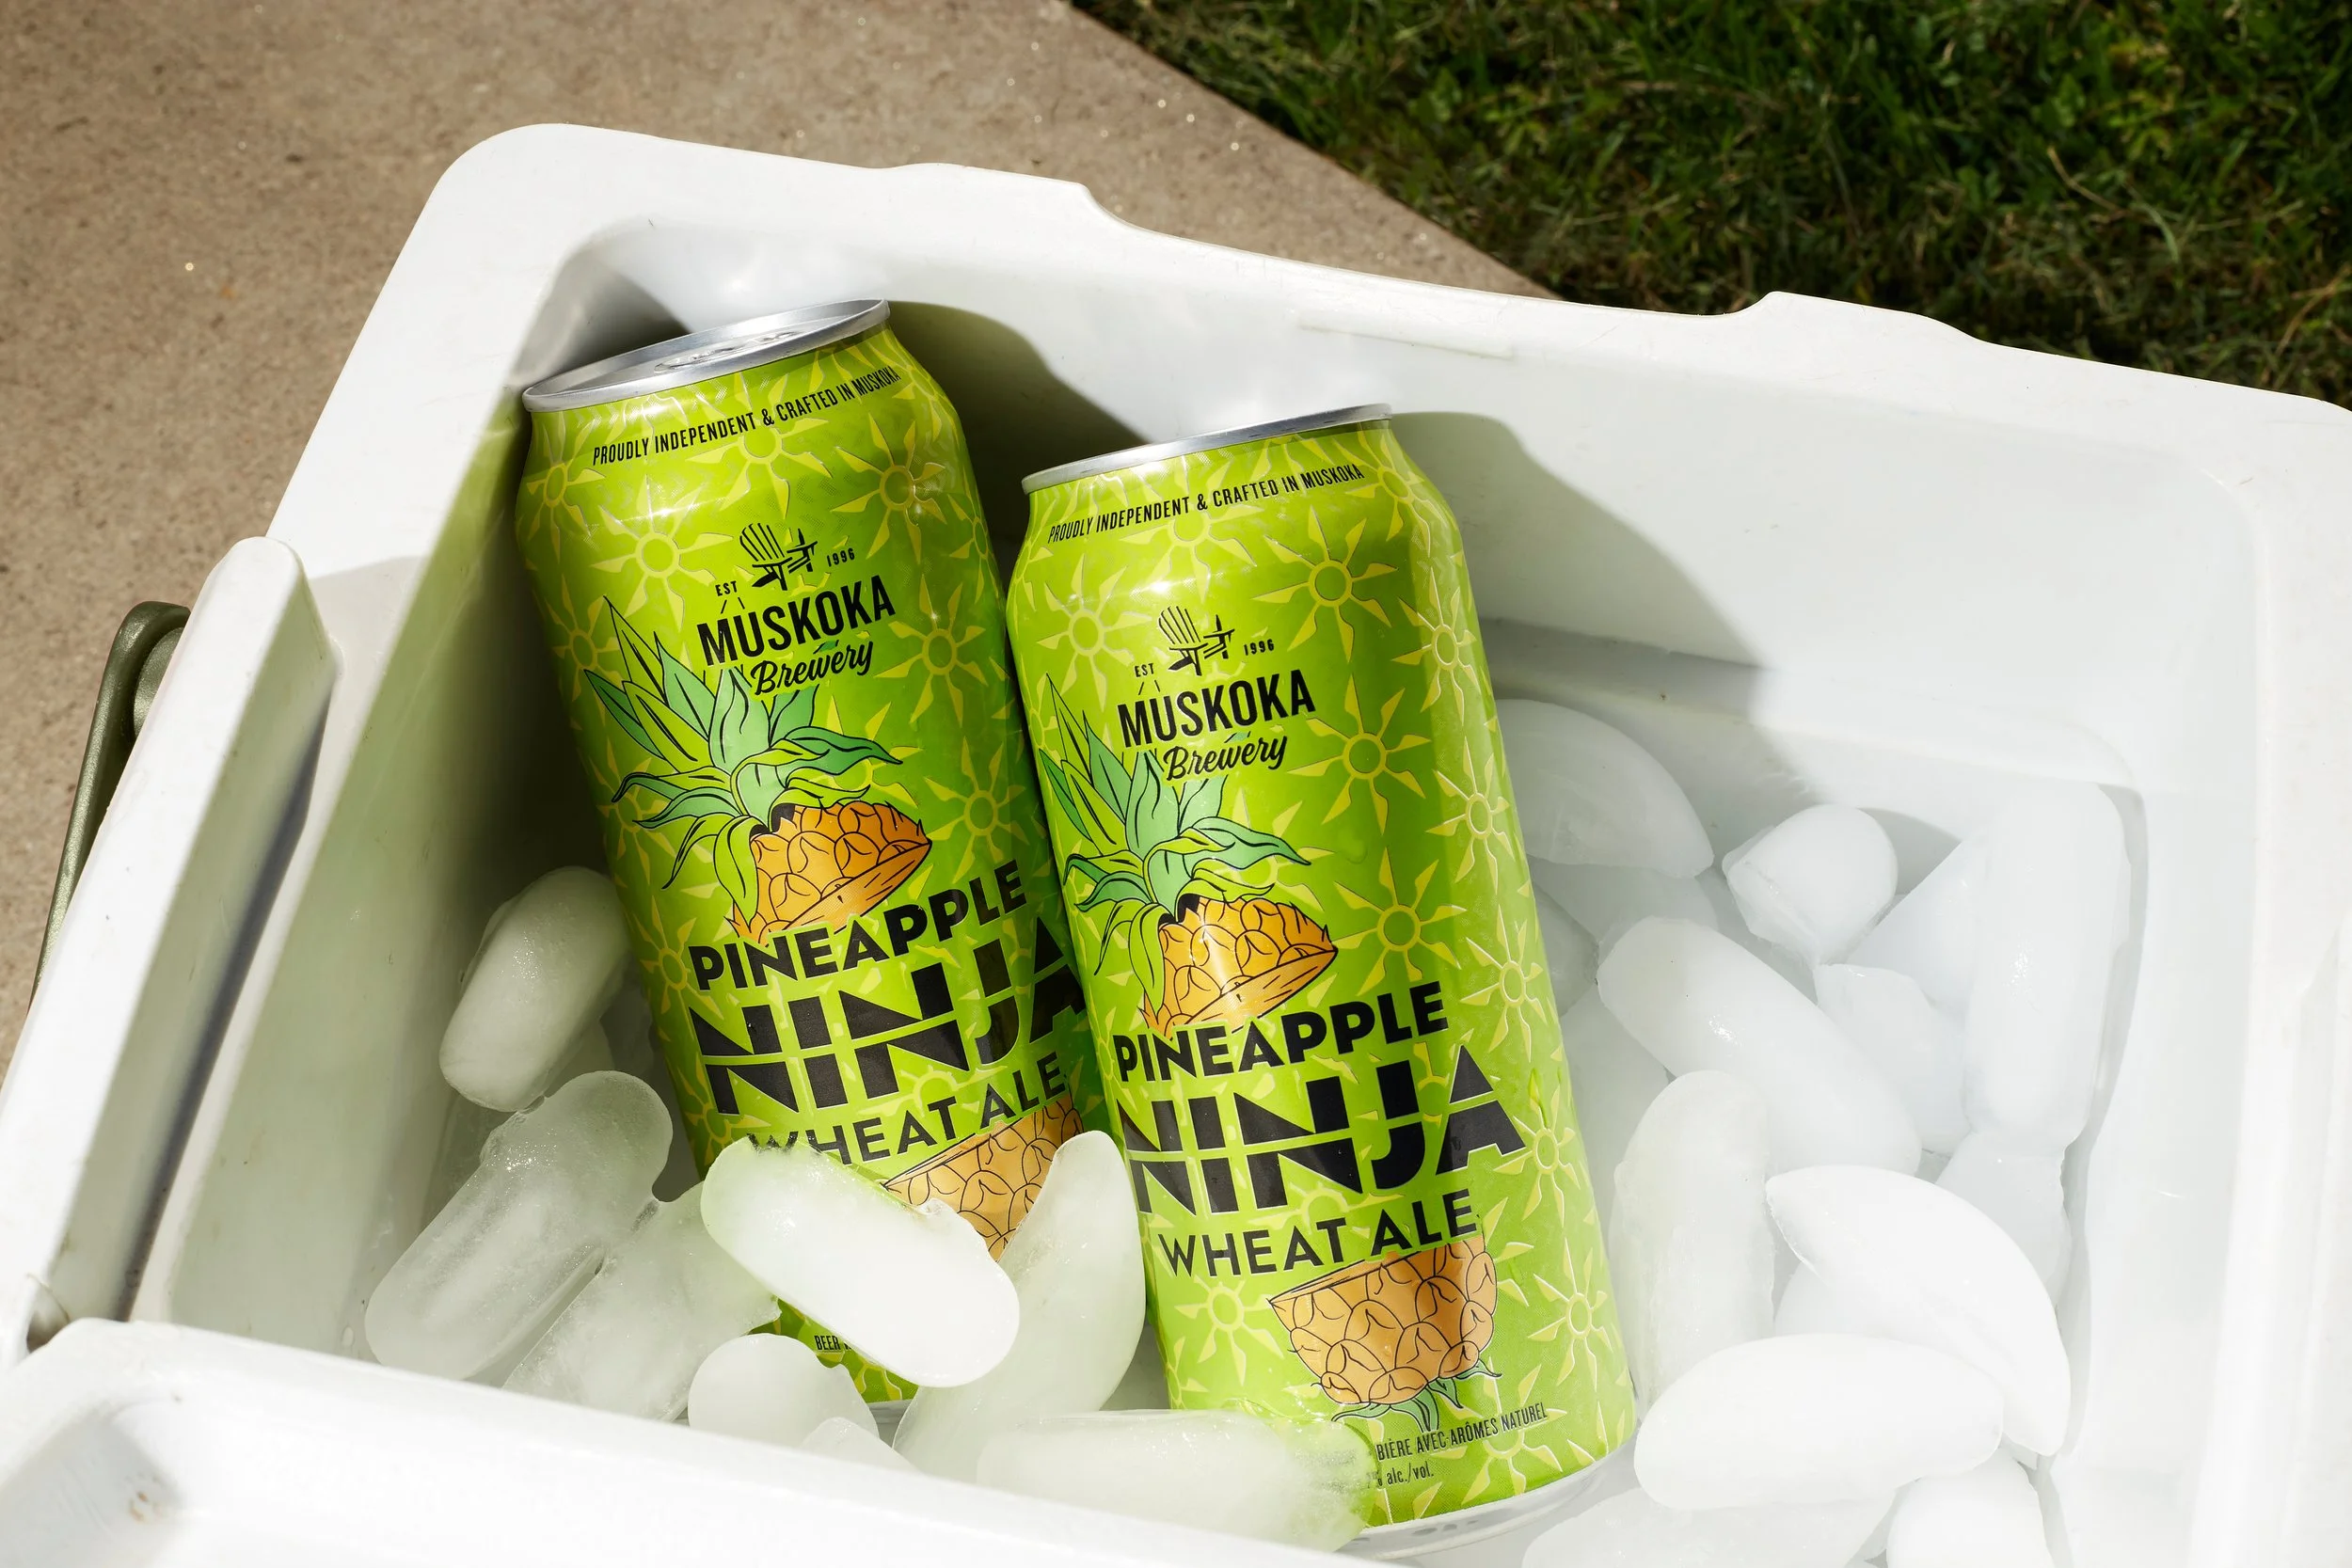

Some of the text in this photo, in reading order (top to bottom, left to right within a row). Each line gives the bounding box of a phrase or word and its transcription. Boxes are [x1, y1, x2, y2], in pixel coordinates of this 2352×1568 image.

[592, 366, 901, 467] PROUDLY INDEPENDENT & CRAFTED IN MUSKOKA
[1048, 463, 1366, 544] PROUDLY INDEPENDENT & CRAFTED IN MUSKOKA
[715, 548, 856, 596] EST 1996
[696, 575, 897, 667] MUSKOKA
[1134, 639, 1276, 678] EST 1996
[750, 638, 875, 696] Brewery
[1117, 669, 1317, 750] MUSKOKA
[1162, 733, 1289, 782] Brewery
[689, 860, 1027, 991] PINEAPPLE
[689, 915, 1087, 1116] NINJA
[1113, 981, 1449, 1083] PINEAPPLE
[979, 1052, 1066, 1131] ALE
[1117, 1045, 1527, 1215] NINJA
[1158, 1188, 1477, 1277] WHEAT ALE
[814, 1335, 841, 1351] BEER
[1376, 1402, 1548, 1462] BIÈRE AVEC ARÔMES NATUREL
[1386, 1461, 1435, 1485] alc./vol.
